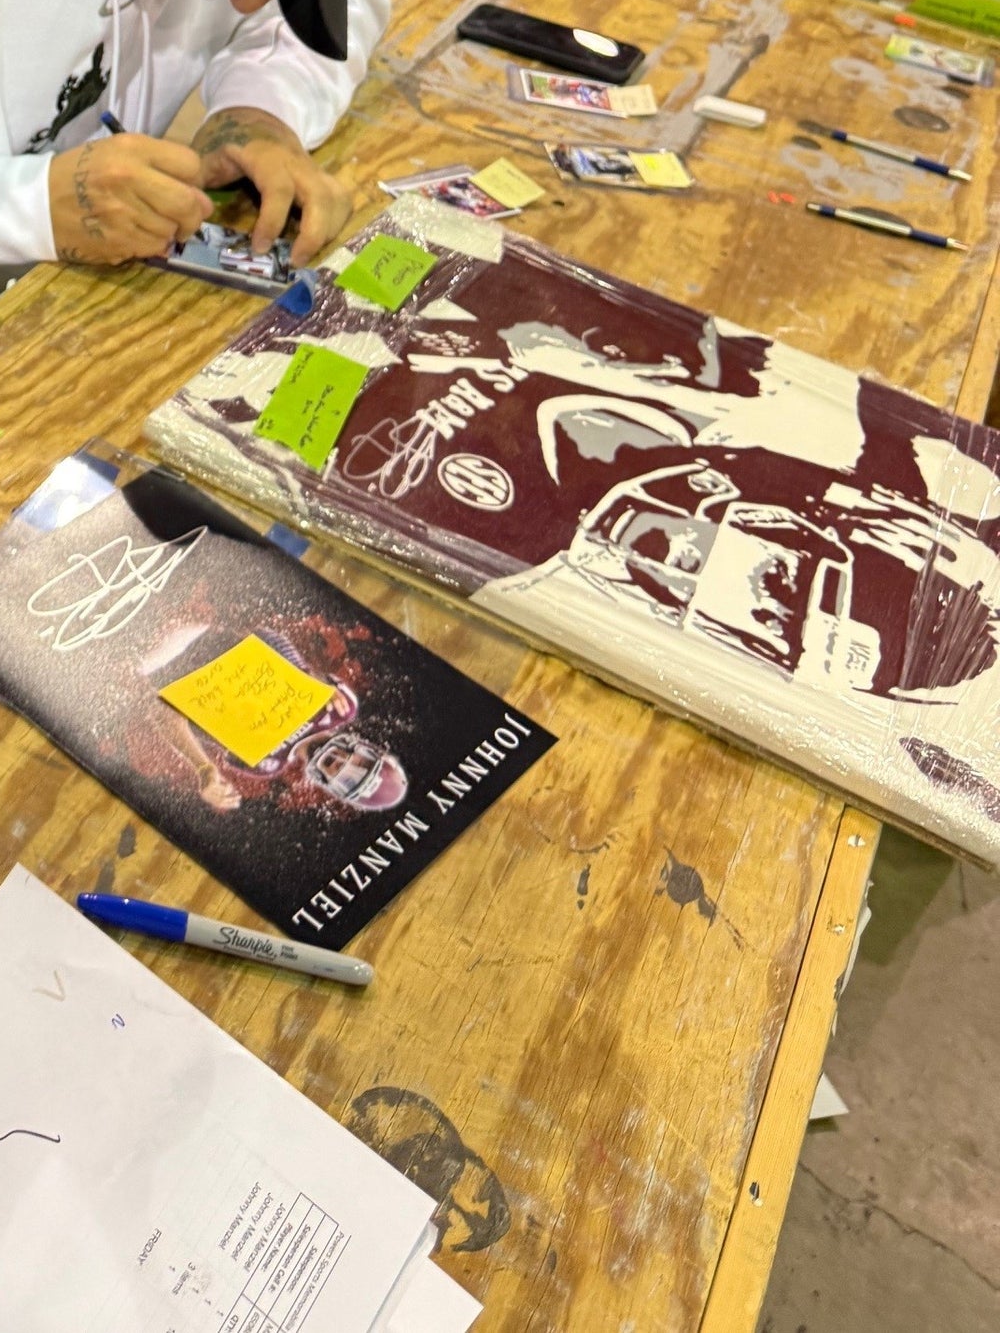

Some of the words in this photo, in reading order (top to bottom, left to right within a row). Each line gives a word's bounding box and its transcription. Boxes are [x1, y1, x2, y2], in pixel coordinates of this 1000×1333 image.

[416, 377, 495, 441] A&M
[441, 456, 512, 508] SEC
[427, 713, 531, 814] JOHNNY
[292, 812, 429, 930] MANZIEL
[213, 927, 273, 957] Sharpie
[239, 1181, 263, 1215] Johnny
[251, 1192, 275, 1226] Johnny
[218, 1214, 243, 1251] Manziel
[263, 1202, 286, 1236] Johnny
[273, 1222, 293, 1253] Player
[138, 1228, 162, 1266] FRIDAY
[231, 1224, 256, 1262] Manziel
[243, 1235, 268, 1273] Manziel
[311, 1258, 329, 1283] Sports
